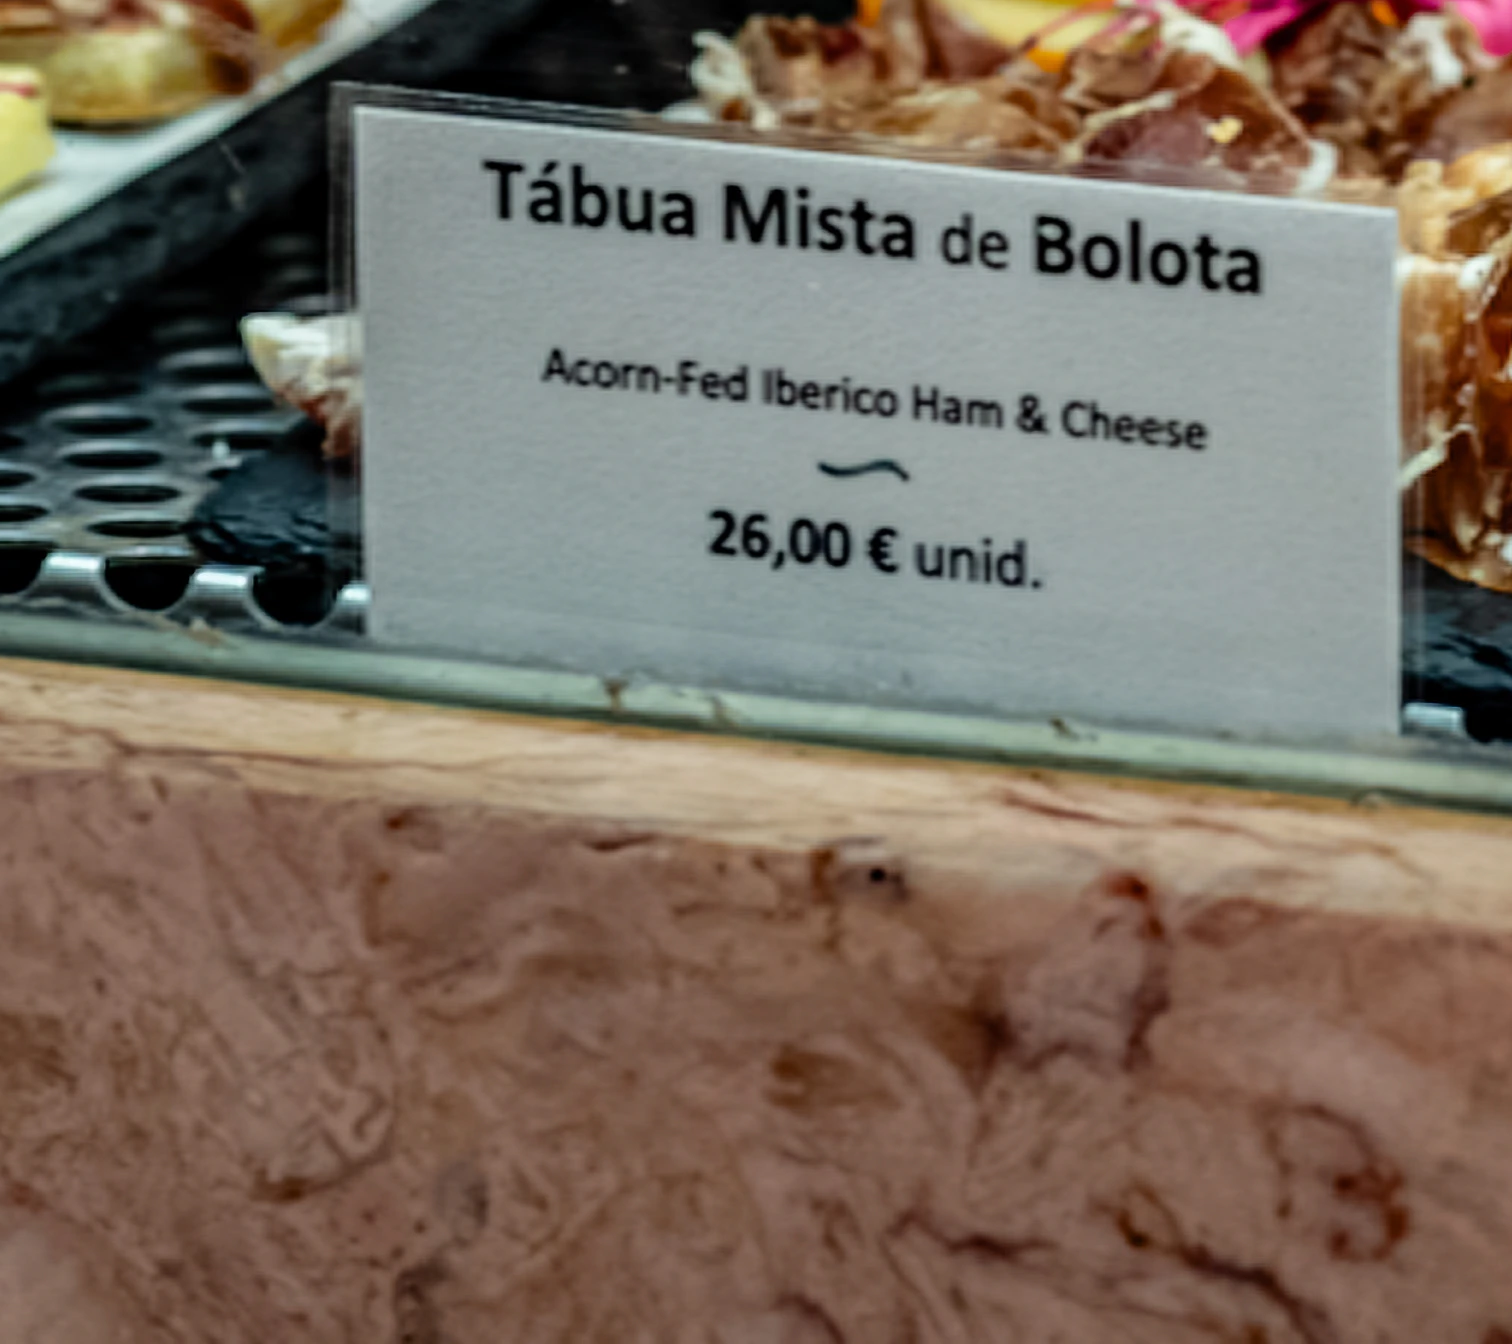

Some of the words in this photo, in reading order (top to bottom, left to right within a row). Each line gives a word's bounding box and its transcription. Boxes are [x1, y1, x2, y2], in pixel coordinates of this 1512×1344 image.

[481, 159, 696, 238] Tábua
[723, 183, 916, 260] Mista
[940, 213, 1010, 271] de
[1034, 214, 1262, 296] Bolota
[541, 347, 749, 403] Acorn-Fed
[762, 368, 900, 419] Iberico
[912, 385, 1004, 429] Ham
[1016, 394, 1049, 434] &
[1060, 399, 1208, 451] Cheese
[708, 509, 853, 571] 26,00
[866, 526, 900, 574] €
[914, 537, 1042, 590] unid.
